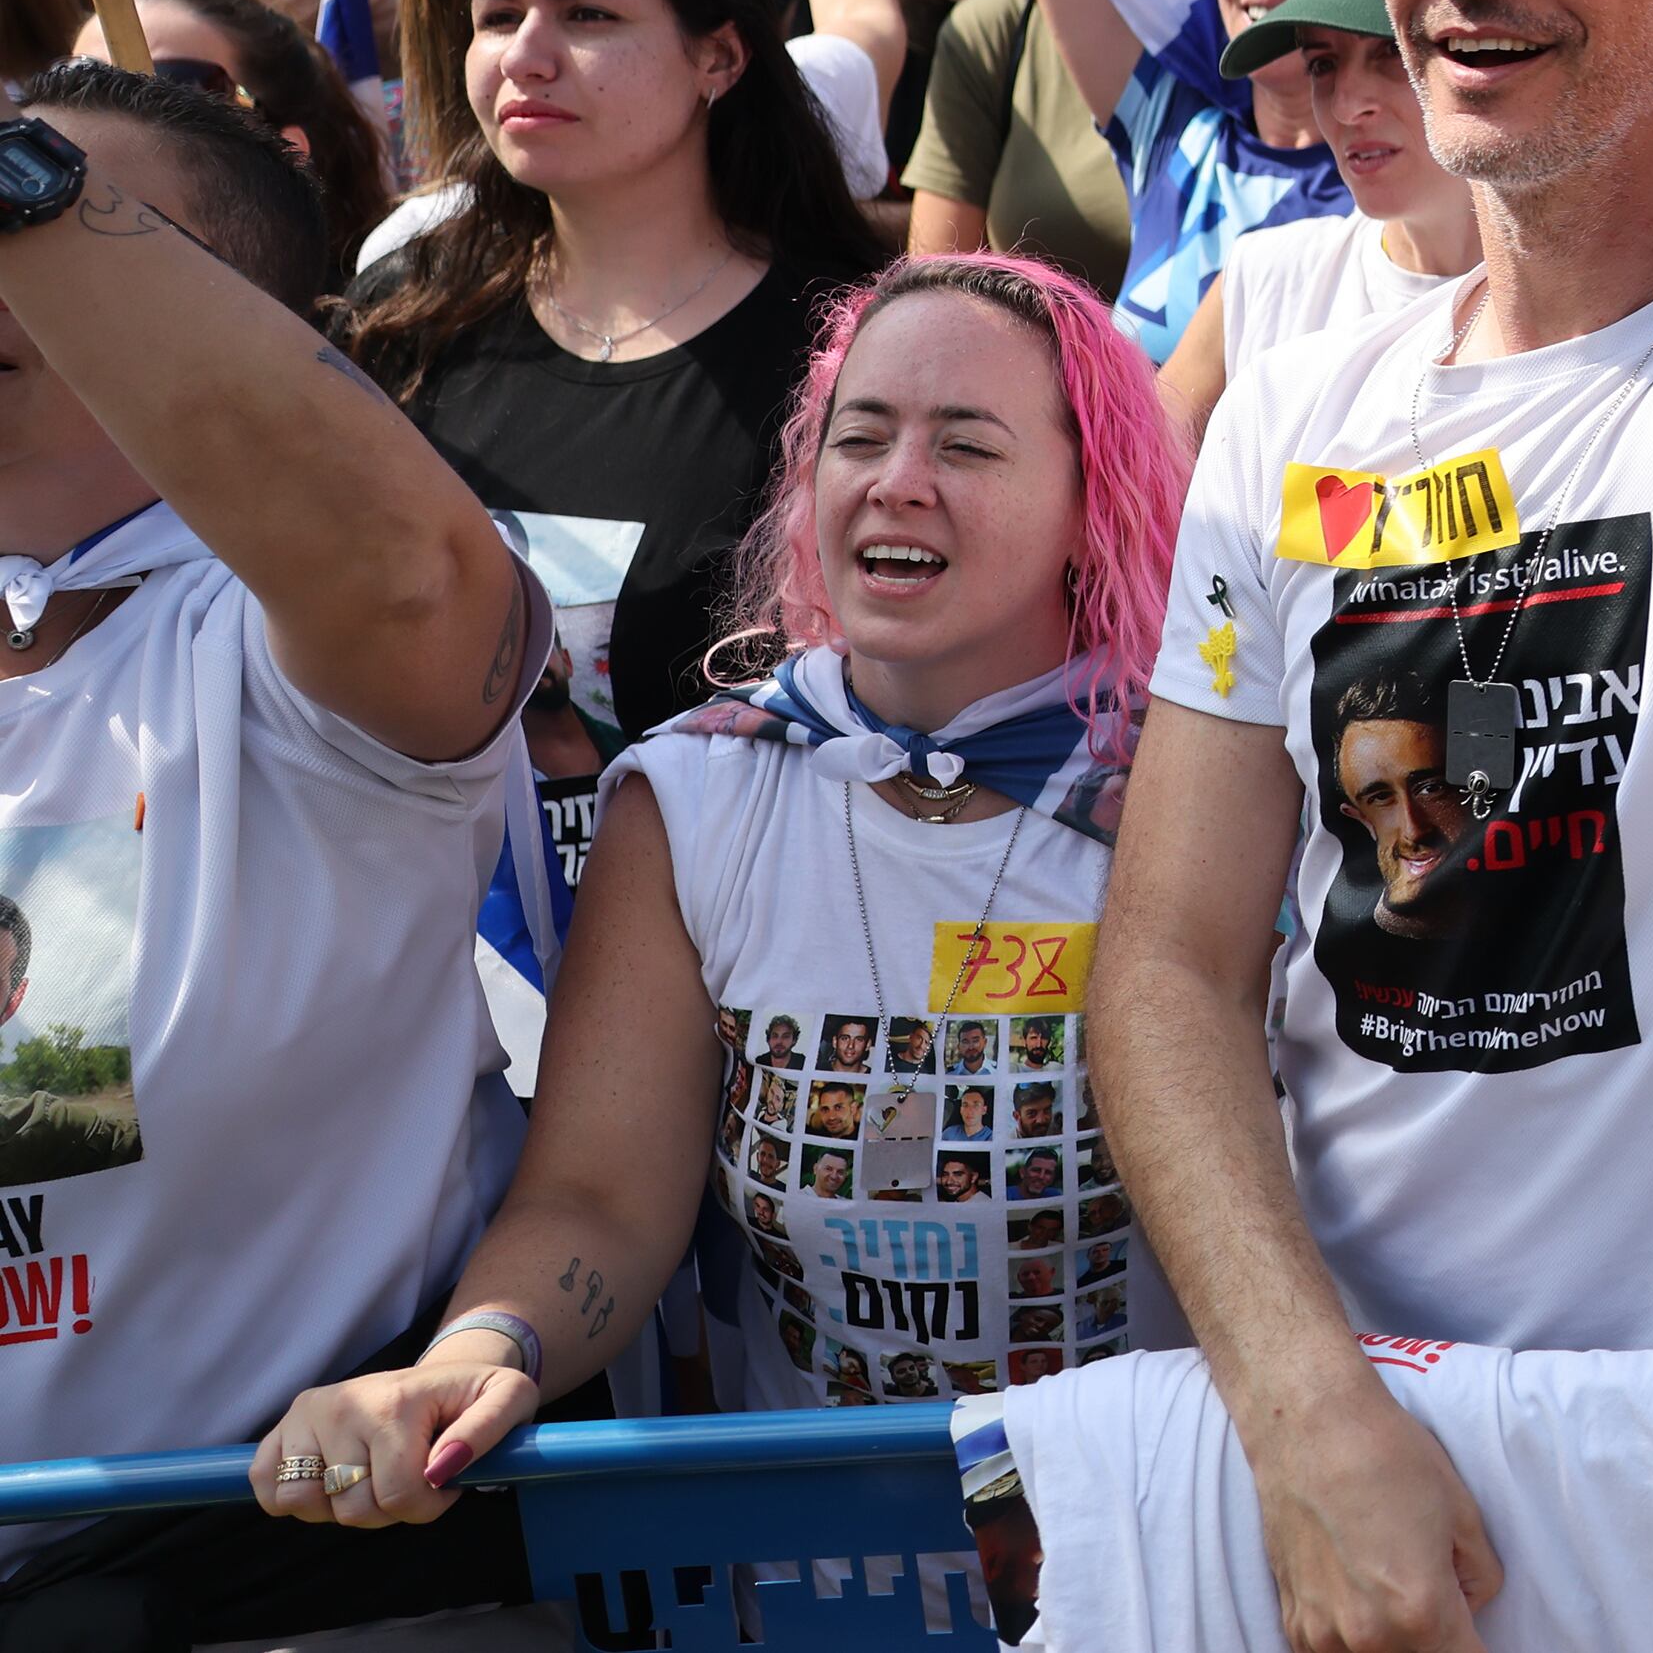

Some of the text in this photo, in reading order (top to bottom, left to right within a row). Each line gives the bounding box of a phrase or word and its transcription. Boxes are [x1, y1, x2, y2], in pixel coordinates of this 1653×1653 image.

[1469, 566, 1492, 595] is
[1546, 548, 1627, 583] alive.
[1513, 663, 1641, 730] אבינ
[1466, 810, 1607, 871] חיים.
[958, 933, 1068, 999] 738
